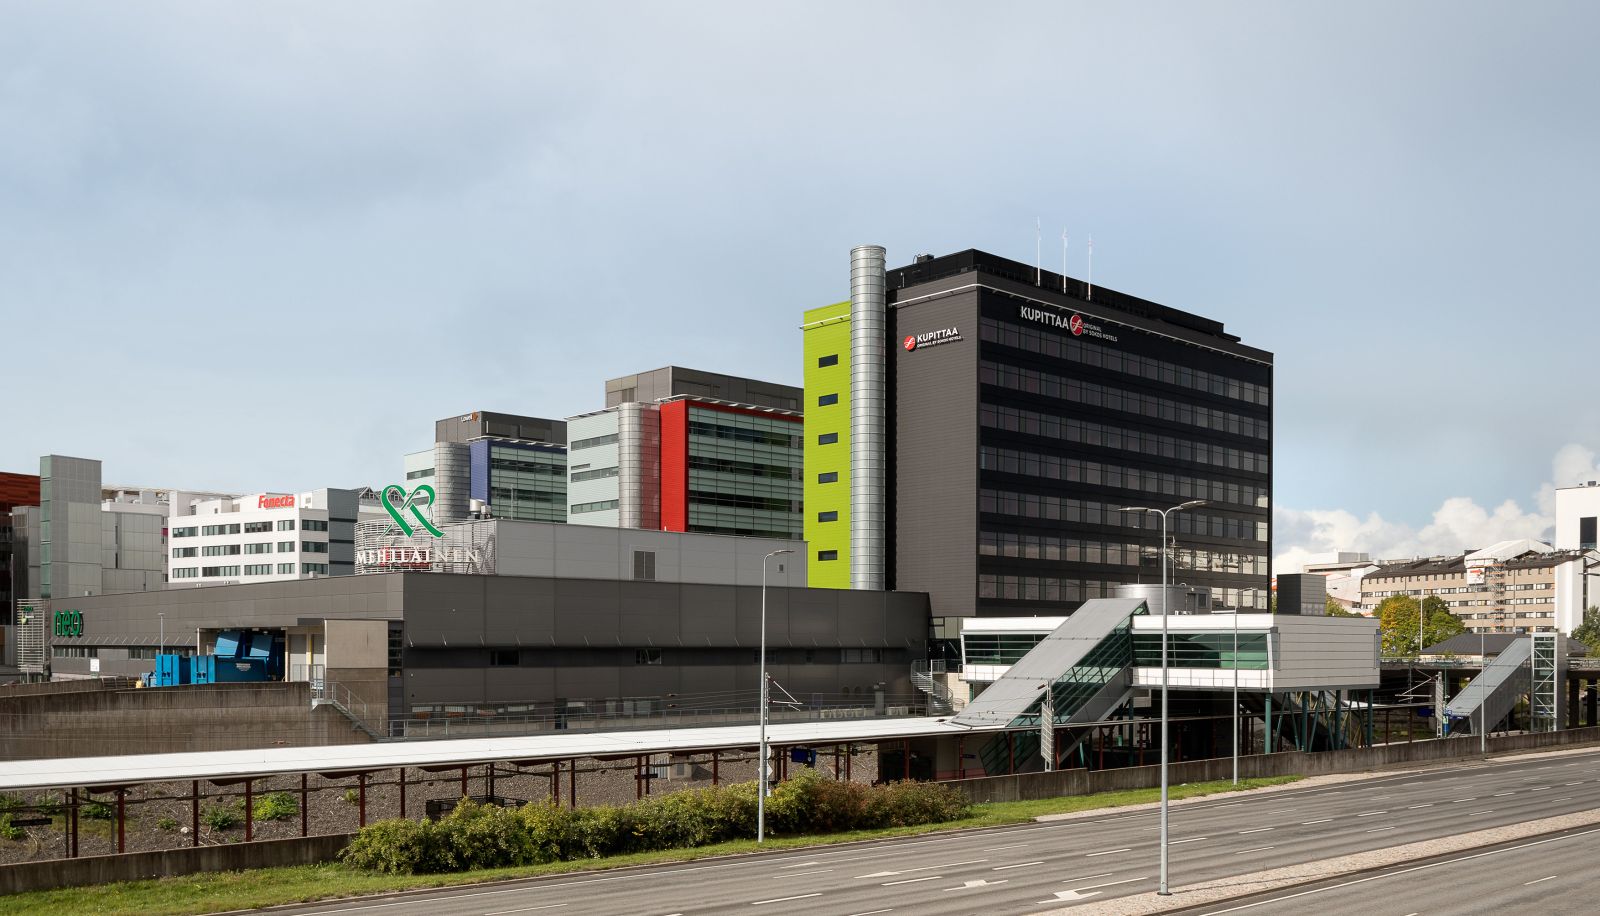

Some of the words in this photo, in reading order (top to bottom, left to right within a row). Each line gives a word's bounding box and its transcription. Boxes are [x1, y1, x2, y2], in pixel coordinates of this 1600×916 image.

[1020, 305, 1070, 330] KUPITTAA
[917, 327, 959, 343] KUPITTAA
[258, 495, 295, 509] Fonecta
[355, 546, 480, 565] MEHILÄINEN
